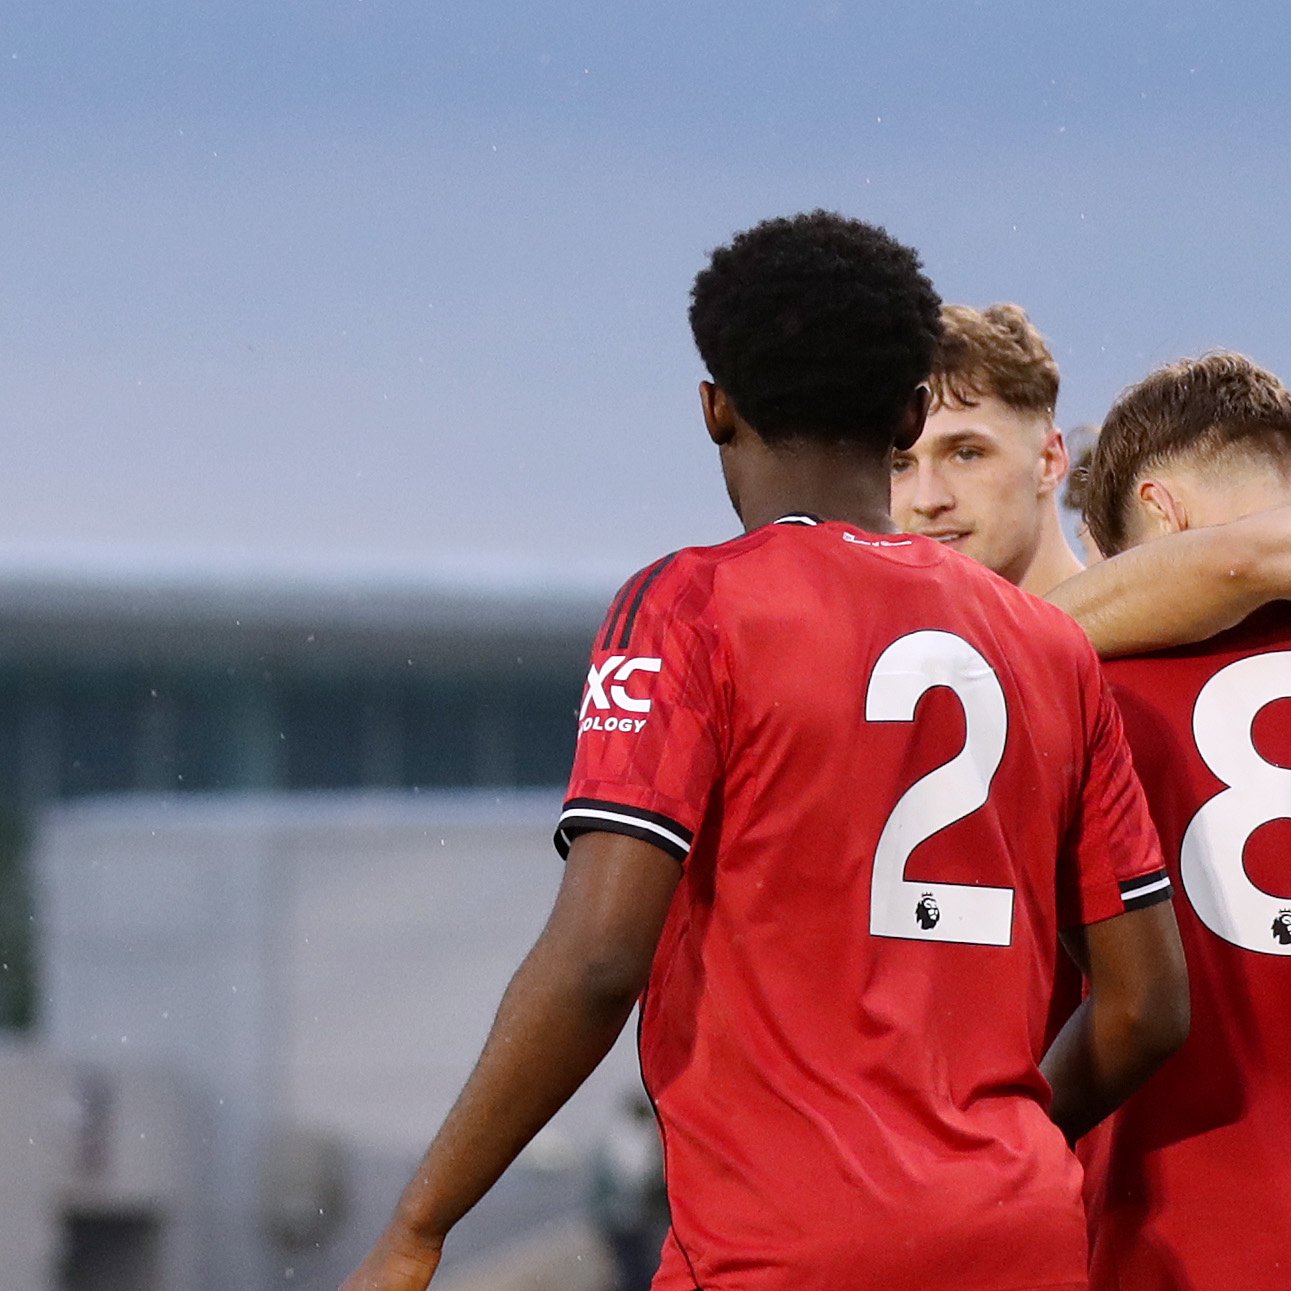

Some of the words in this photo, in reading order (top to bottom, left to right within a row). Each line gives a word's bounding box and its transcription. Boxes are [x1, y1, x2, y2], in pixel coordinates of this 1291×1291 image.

[579, 655, 662, 721] XC
[578, 716, 648, 734] OLOGY
[864, 628, 1015, 947] 2
